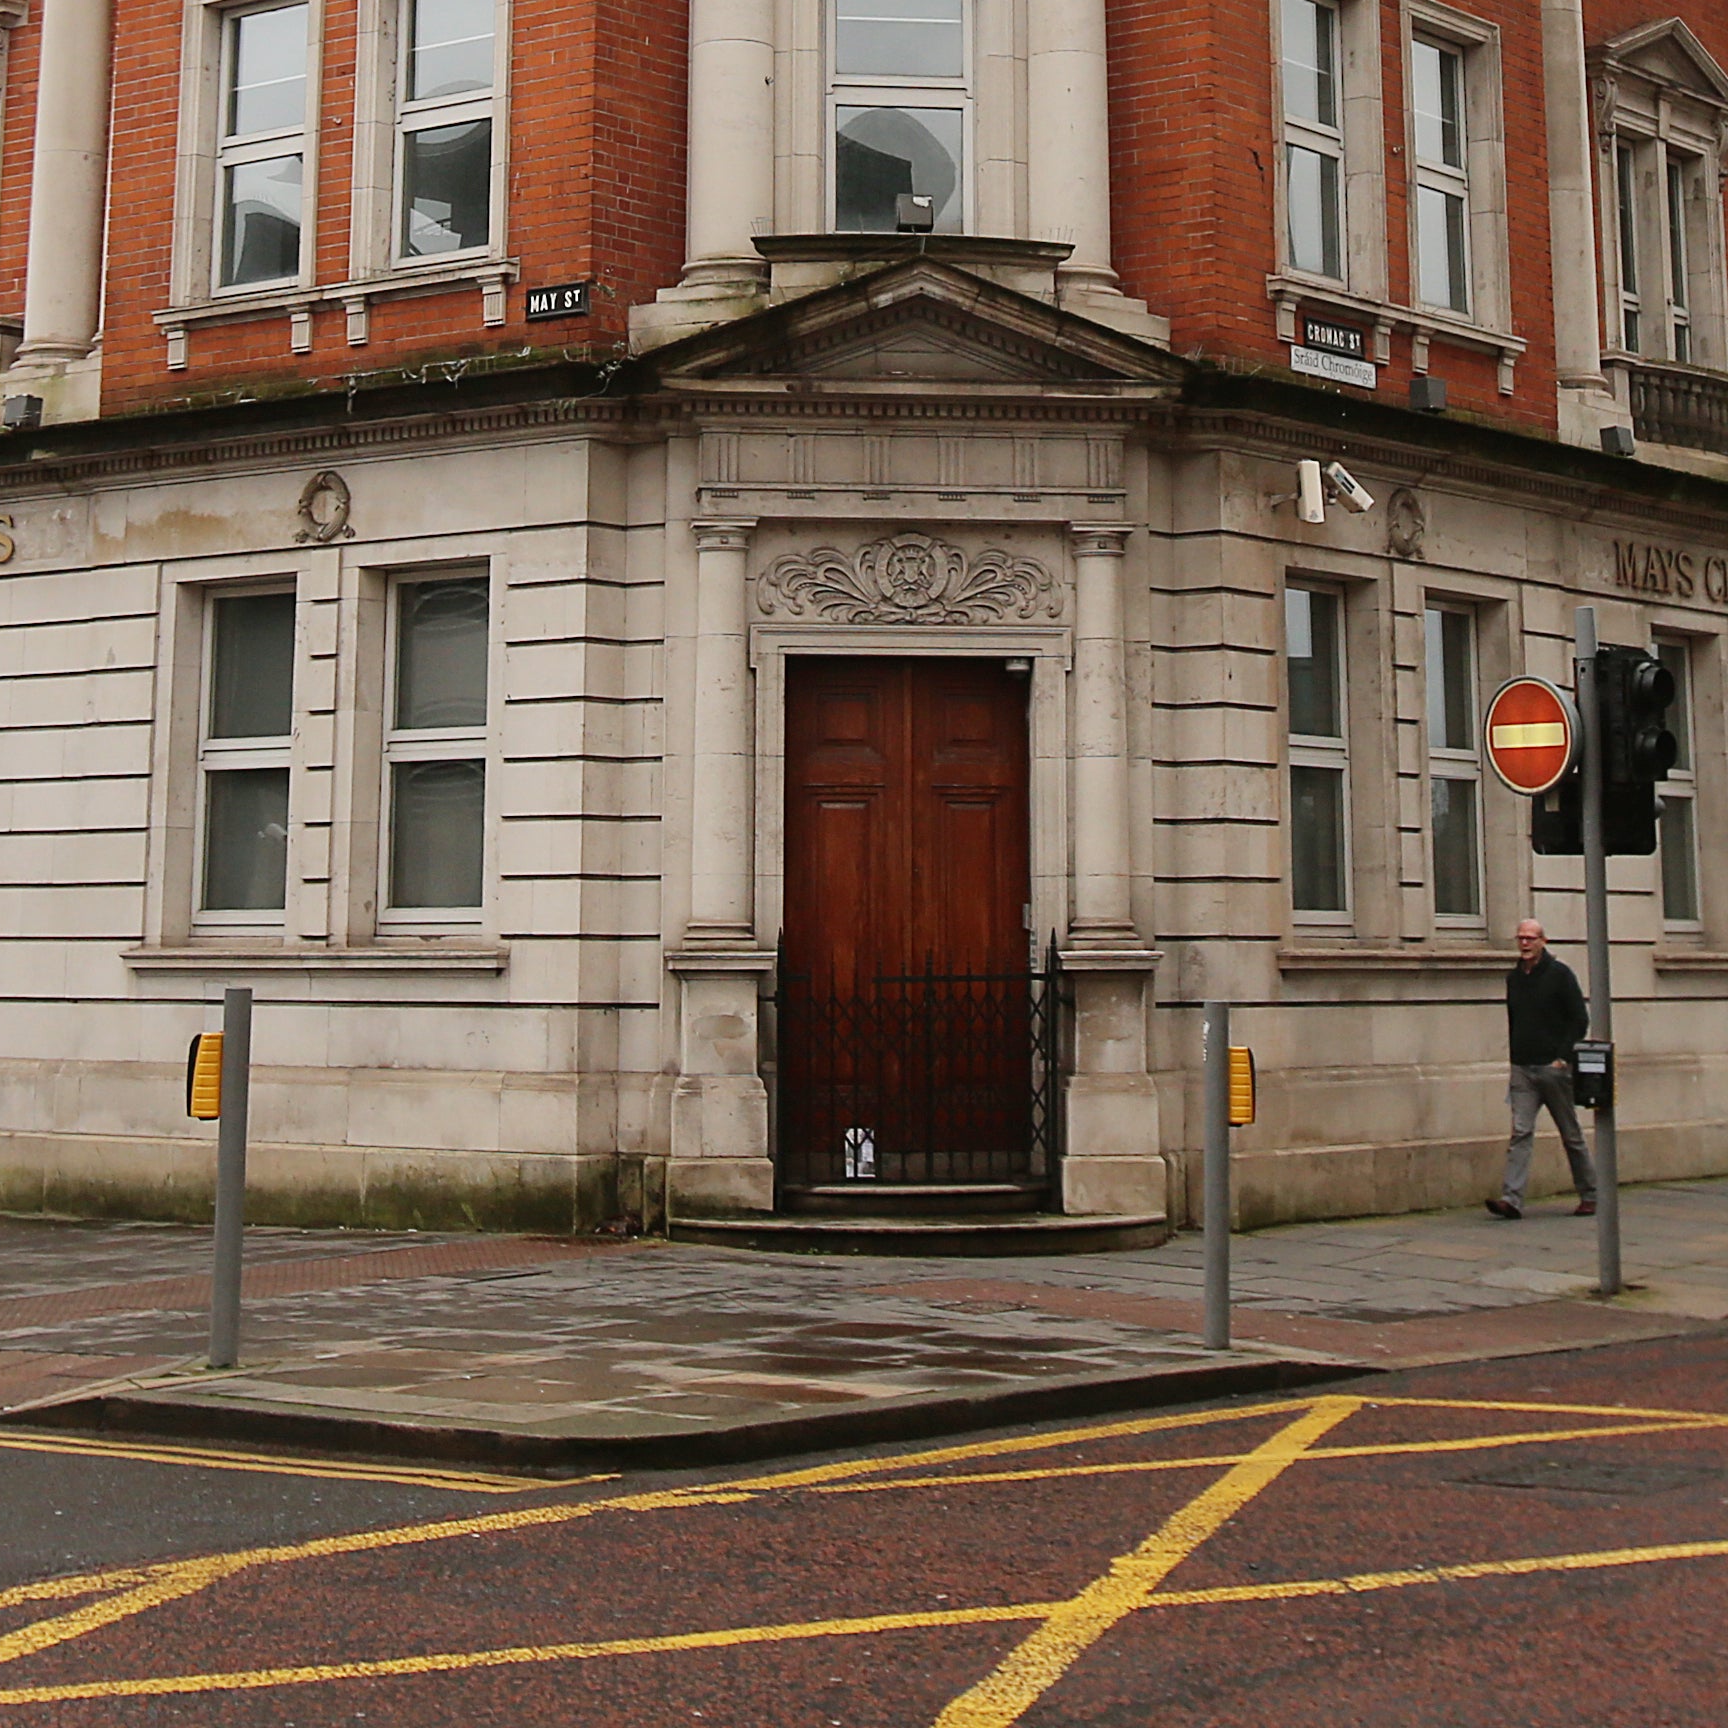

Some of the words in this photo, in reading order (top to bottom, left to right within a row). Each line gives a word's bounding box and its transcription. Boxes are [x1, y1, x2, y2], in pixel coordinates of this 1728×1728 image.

[530, 292, 557, 313] MAY
[564, 289, 580, 308] ST
[1307, 324, 1345, 348] CROMAC
[1349, 333, 1361, 349] ST
[1294, 348, 1319, 368] Sráid
[1613, 540, 1694, 598] MAYS
